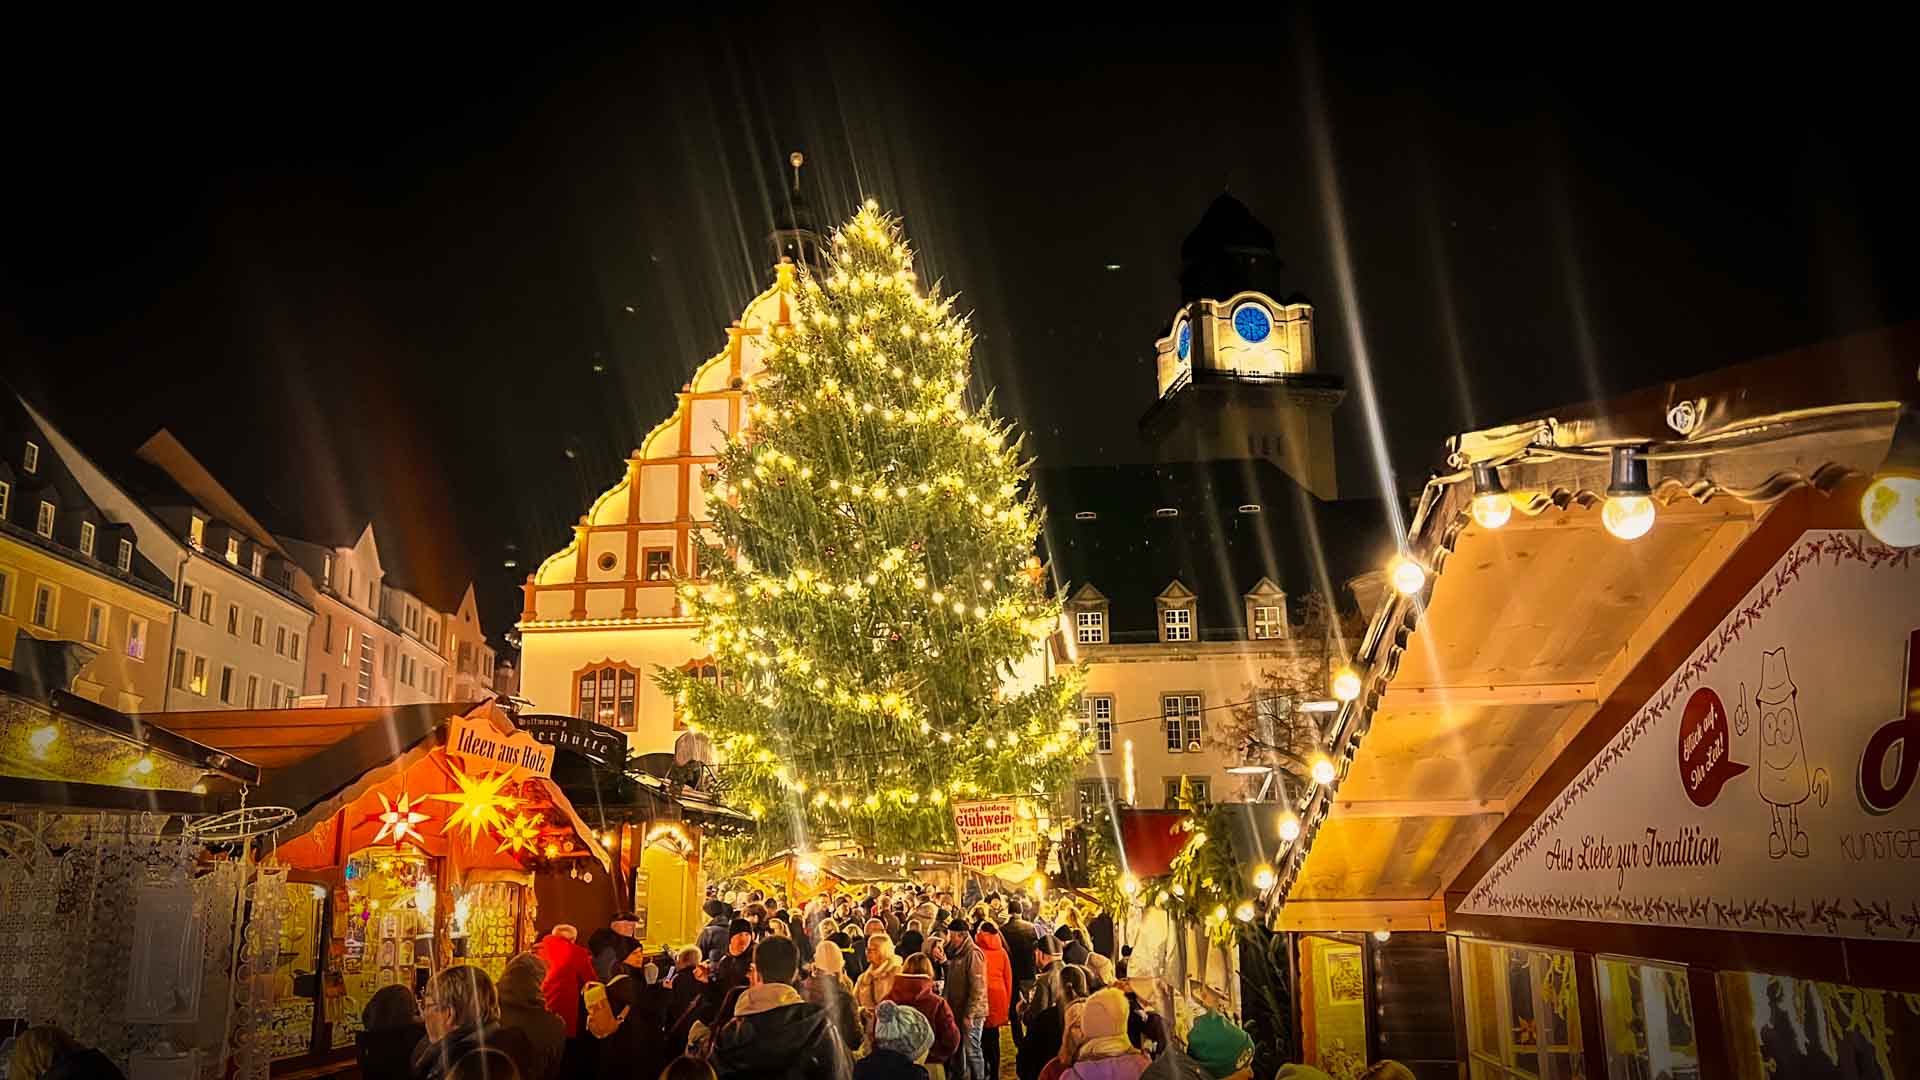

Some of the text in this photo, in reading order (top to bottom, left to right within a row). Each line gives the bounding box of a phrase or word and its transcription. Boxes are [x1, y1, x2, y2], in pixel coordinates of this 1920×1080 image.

[457, 727, 547, 773] Ideen aus Holz
[959, 804, 1010, 814] Verschiedene
[961, 826, 1010, 835] Variationen
[971, 840, 1002, 853] Heißer
[960, 850, 1013, 870] Eierpunsch
[1545, 826, 1721, 891] Aus Liebe zur Tradition
